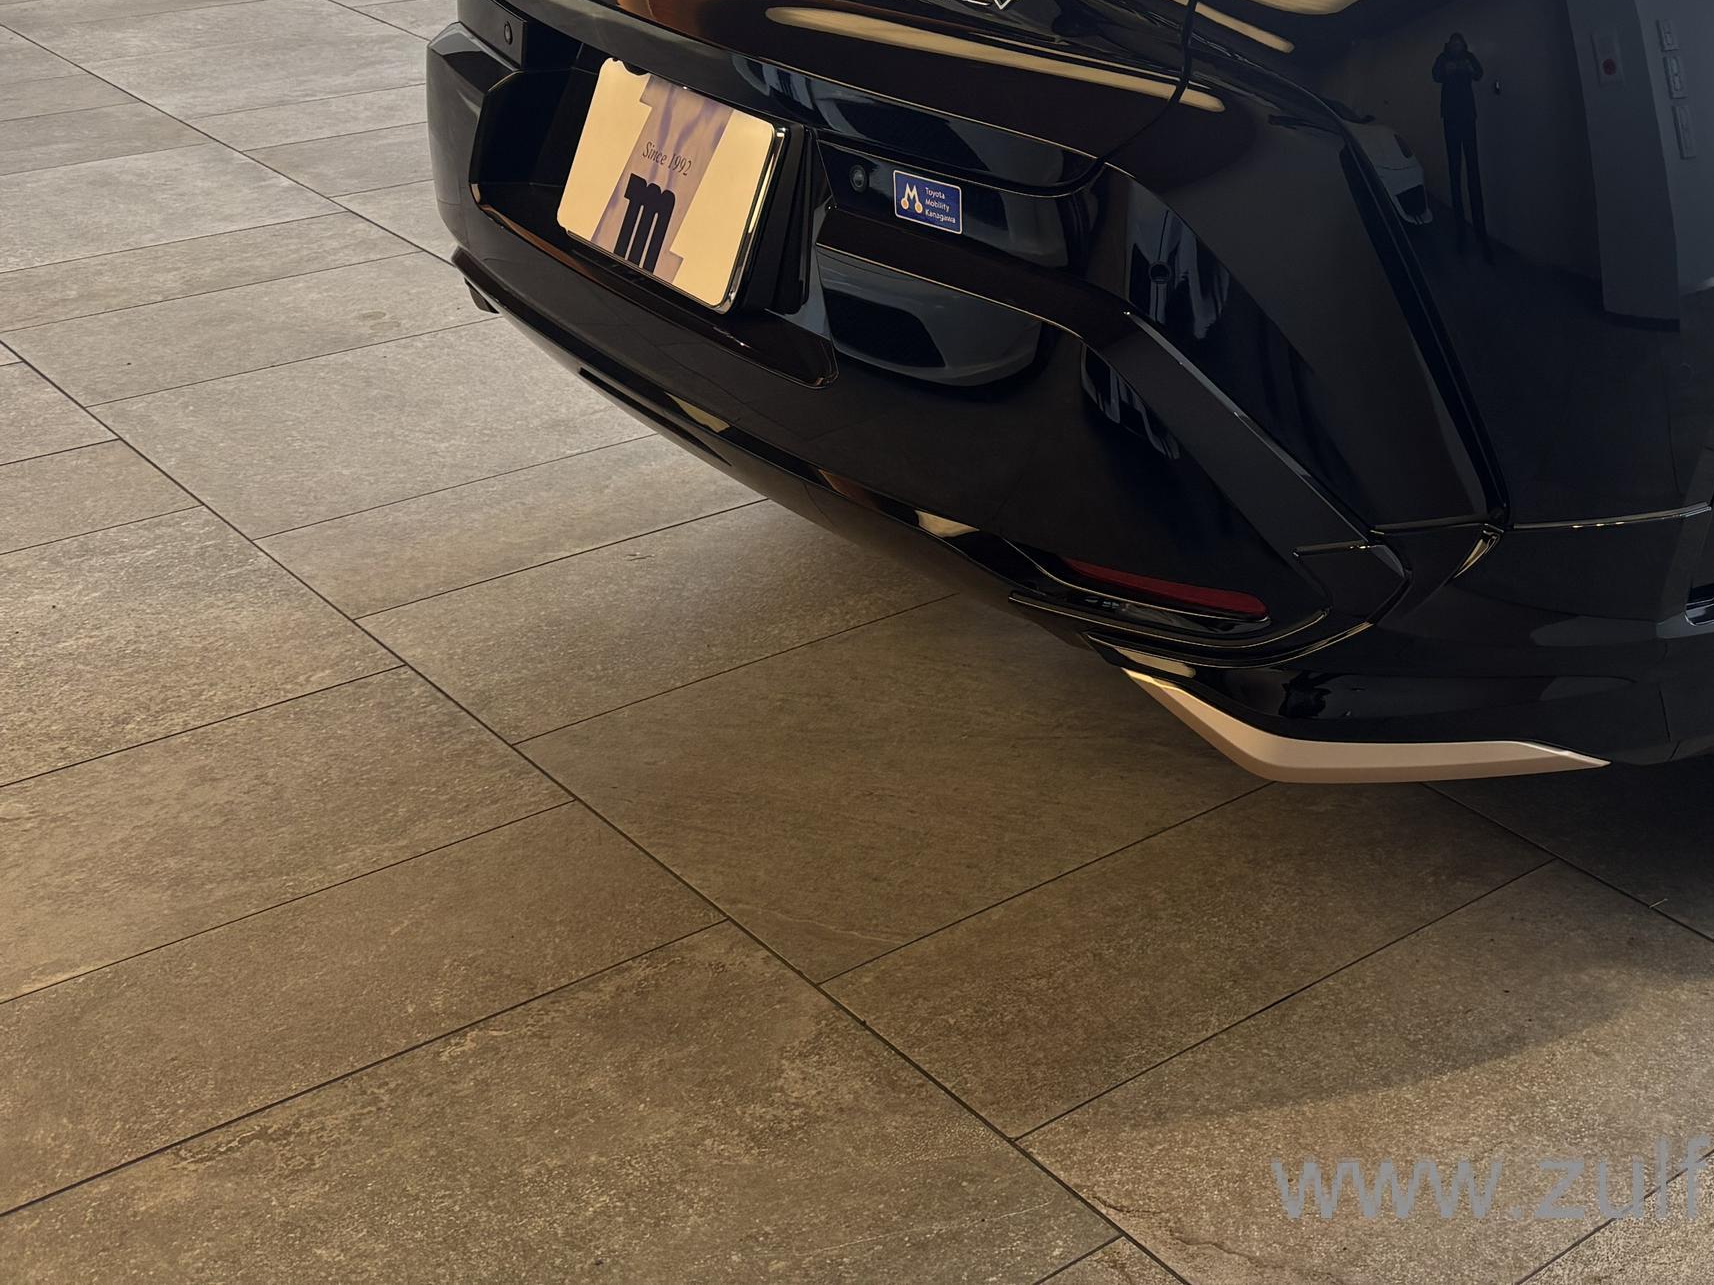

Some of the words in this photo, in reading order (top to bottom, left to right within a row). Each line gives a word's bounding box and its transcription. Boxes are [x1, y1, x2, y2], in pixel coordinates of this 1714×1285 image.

[642, 141, 668, 165] Since
[668, 153, 692, 177] 1992
[925, 187, 946, 200] Toyota
[925, 198, 950, 213] Mobility
[925, 209, 956, 223] Kanagawa
